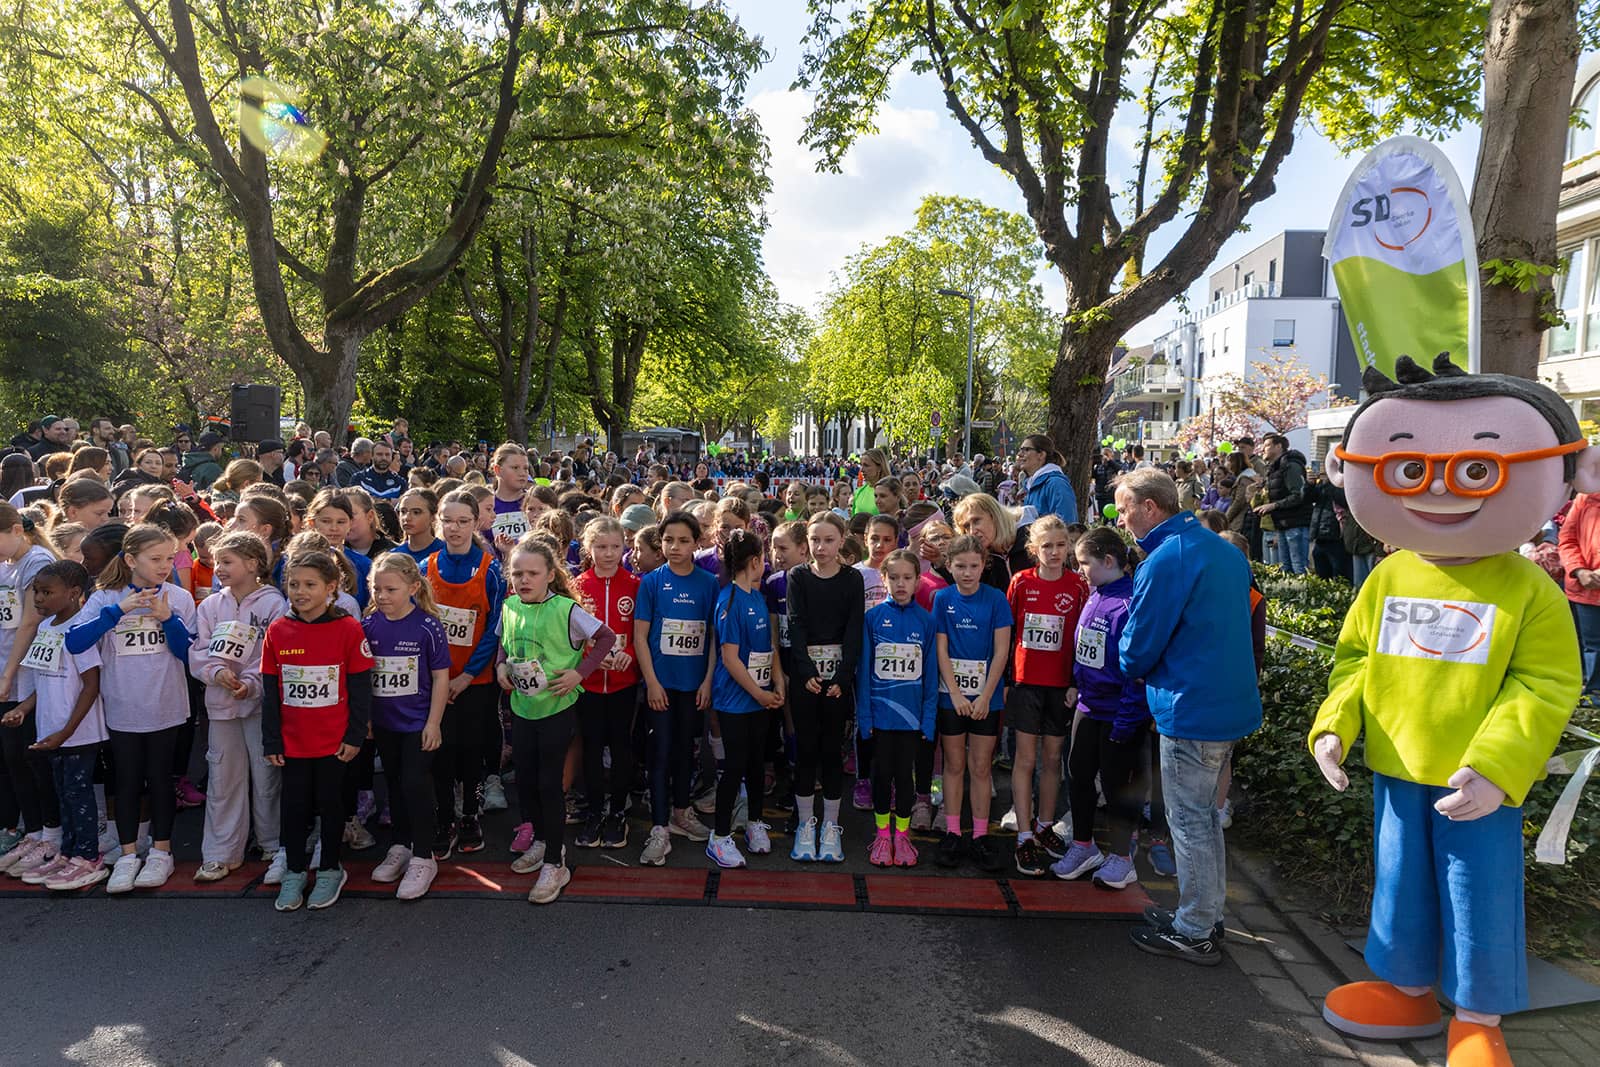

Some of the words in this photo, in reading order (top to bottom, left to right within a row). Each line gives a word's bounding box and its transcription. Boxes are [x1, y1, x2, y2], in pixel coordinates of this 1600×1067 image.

[1350, 193, 1391, 227] SD
[1385, 601, 1440, 625] SD
[125, 630, 165, 647] 2105
[668, 634, 700, 649] 1469
[1028, 629, 1059, 644] 1760
[29, 645, 54, 662] 1413
[209, 639, 245, 658] 4075
[881, 658, 915, 673] 2114
[373, 673, 410, 688] 2148
[289, 683, 330, 699] 2934
